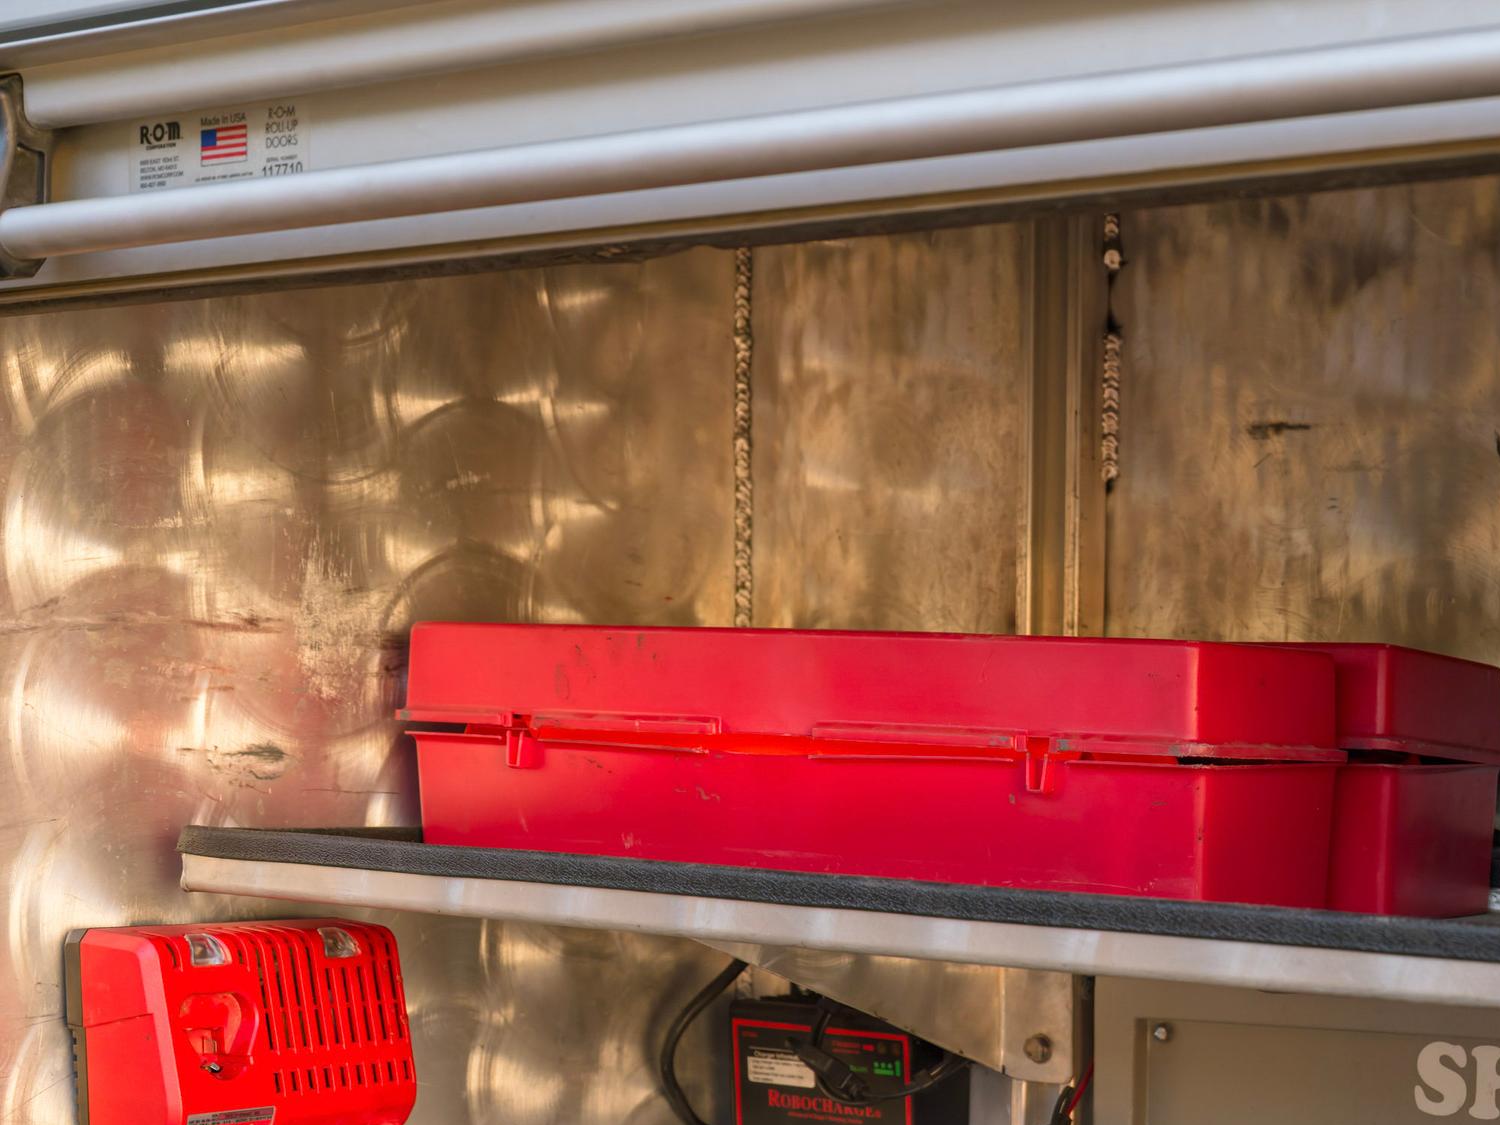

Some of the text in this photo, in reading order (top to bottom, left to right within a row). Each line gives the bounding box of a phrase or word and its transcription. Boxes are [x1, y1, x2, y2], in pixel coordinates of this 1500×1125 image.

[201, 117, 220, 126] Made
[230, 112, 246, 123] USA
[265, 134, 298, 149] DOORS
